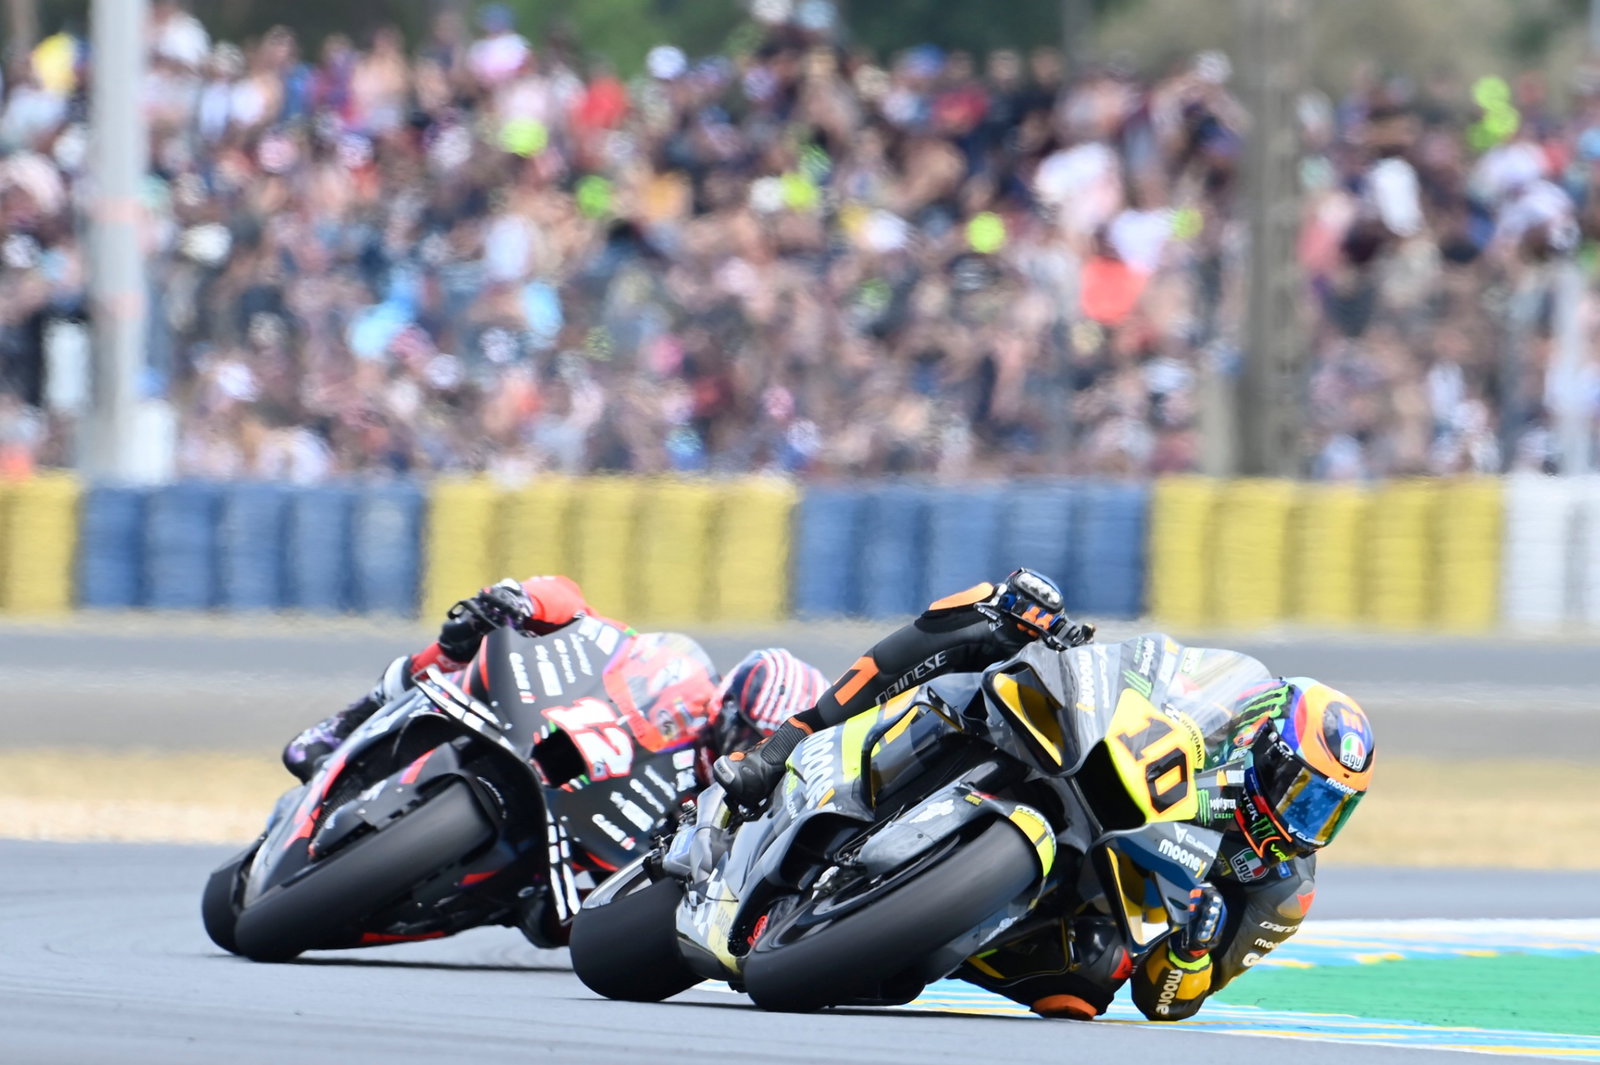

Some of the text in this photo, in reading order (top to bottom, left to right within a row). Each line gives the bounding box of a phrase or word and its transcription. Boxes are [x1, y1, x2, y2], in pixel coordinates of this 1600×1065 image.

[875, 650, 948, 705] DAINESE
[541, 697, 634, 782] 12
[1343, 752, 1362, 768] agv
[1116, 716, 1189, 815] 10
[1158, 839, 1207, 879] mooney
[1235, 857, 1253, 880] agv
